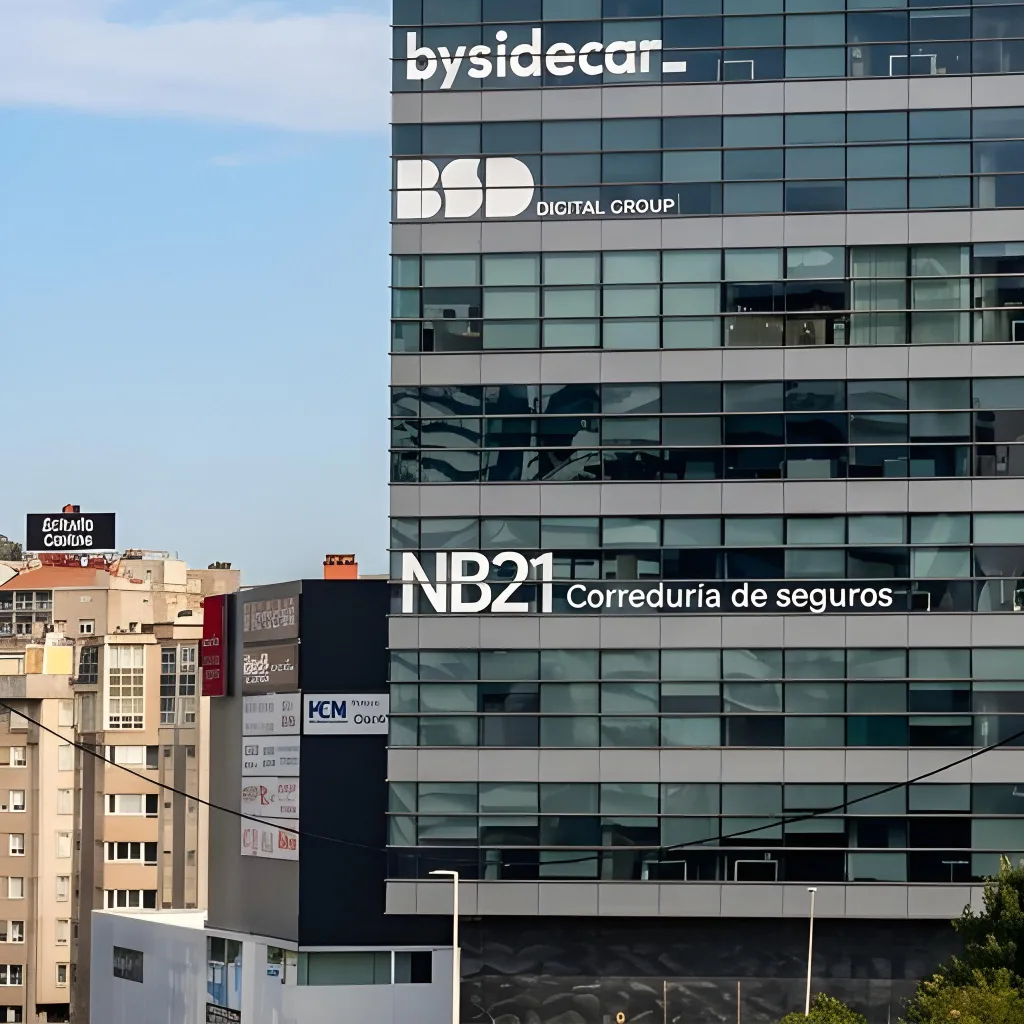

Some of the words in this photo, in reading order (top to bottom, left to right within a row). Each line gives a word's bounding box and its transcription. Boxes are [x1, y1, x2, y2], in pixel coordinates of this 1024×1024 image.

[396, 157, 535, 219] BSD
[536, 200, 606, 216] DIGITAL
[610, 198, 675, 215] GROUP
[401, 551, 554, 614] NB21
[566, 581, 722, 609] Correduría
[731, 583, 768, 608] de
[775, 586, 894, 613] seguros
